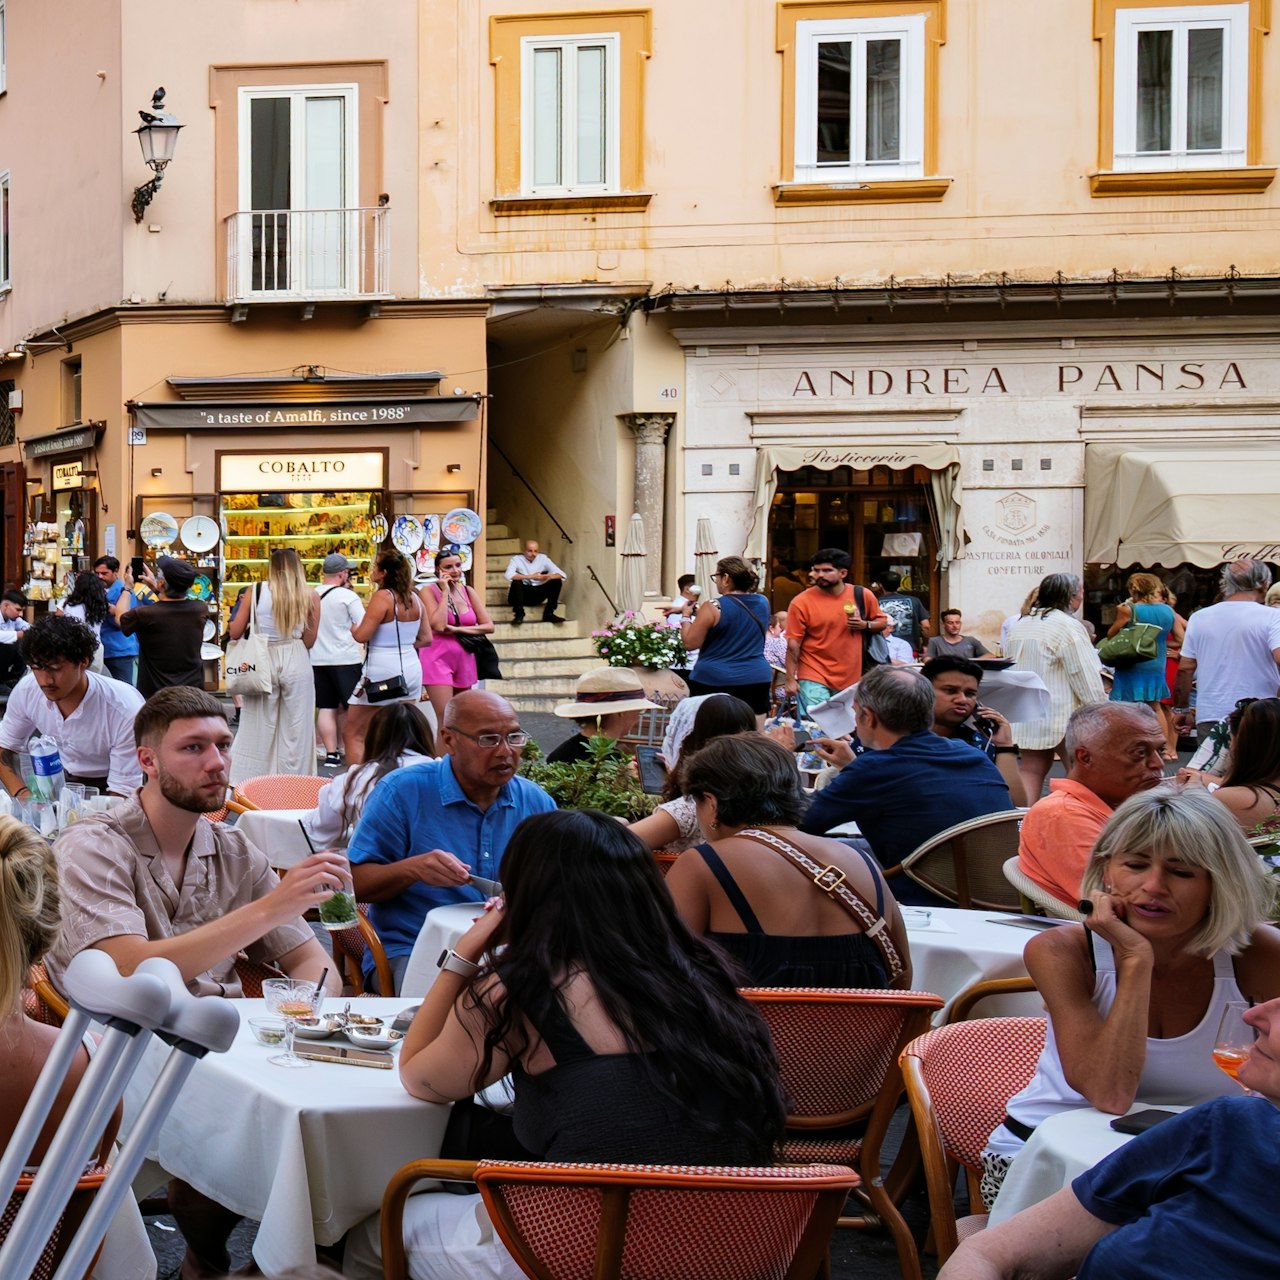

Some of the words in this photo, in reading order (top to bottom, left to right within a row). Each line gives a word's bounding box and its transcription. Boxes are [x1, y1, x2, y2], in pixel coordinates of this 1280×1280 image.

[792, 368, 1009, 397] ANDREA
[1058, 362, 1247, 392] PANSA
[661, 388, 677, 398] 40
[218, 413, 253, 424] taste
[255, 411, 272, 423] of
[273, 410, 327, 424] Amalfi,
[329, 410, 368, 422] since
[802, 448, 919, 464] Pasticceria
[258, 460, 345, 474] COBALTO
[988, 566, 1045, 575] CONFETTURE
